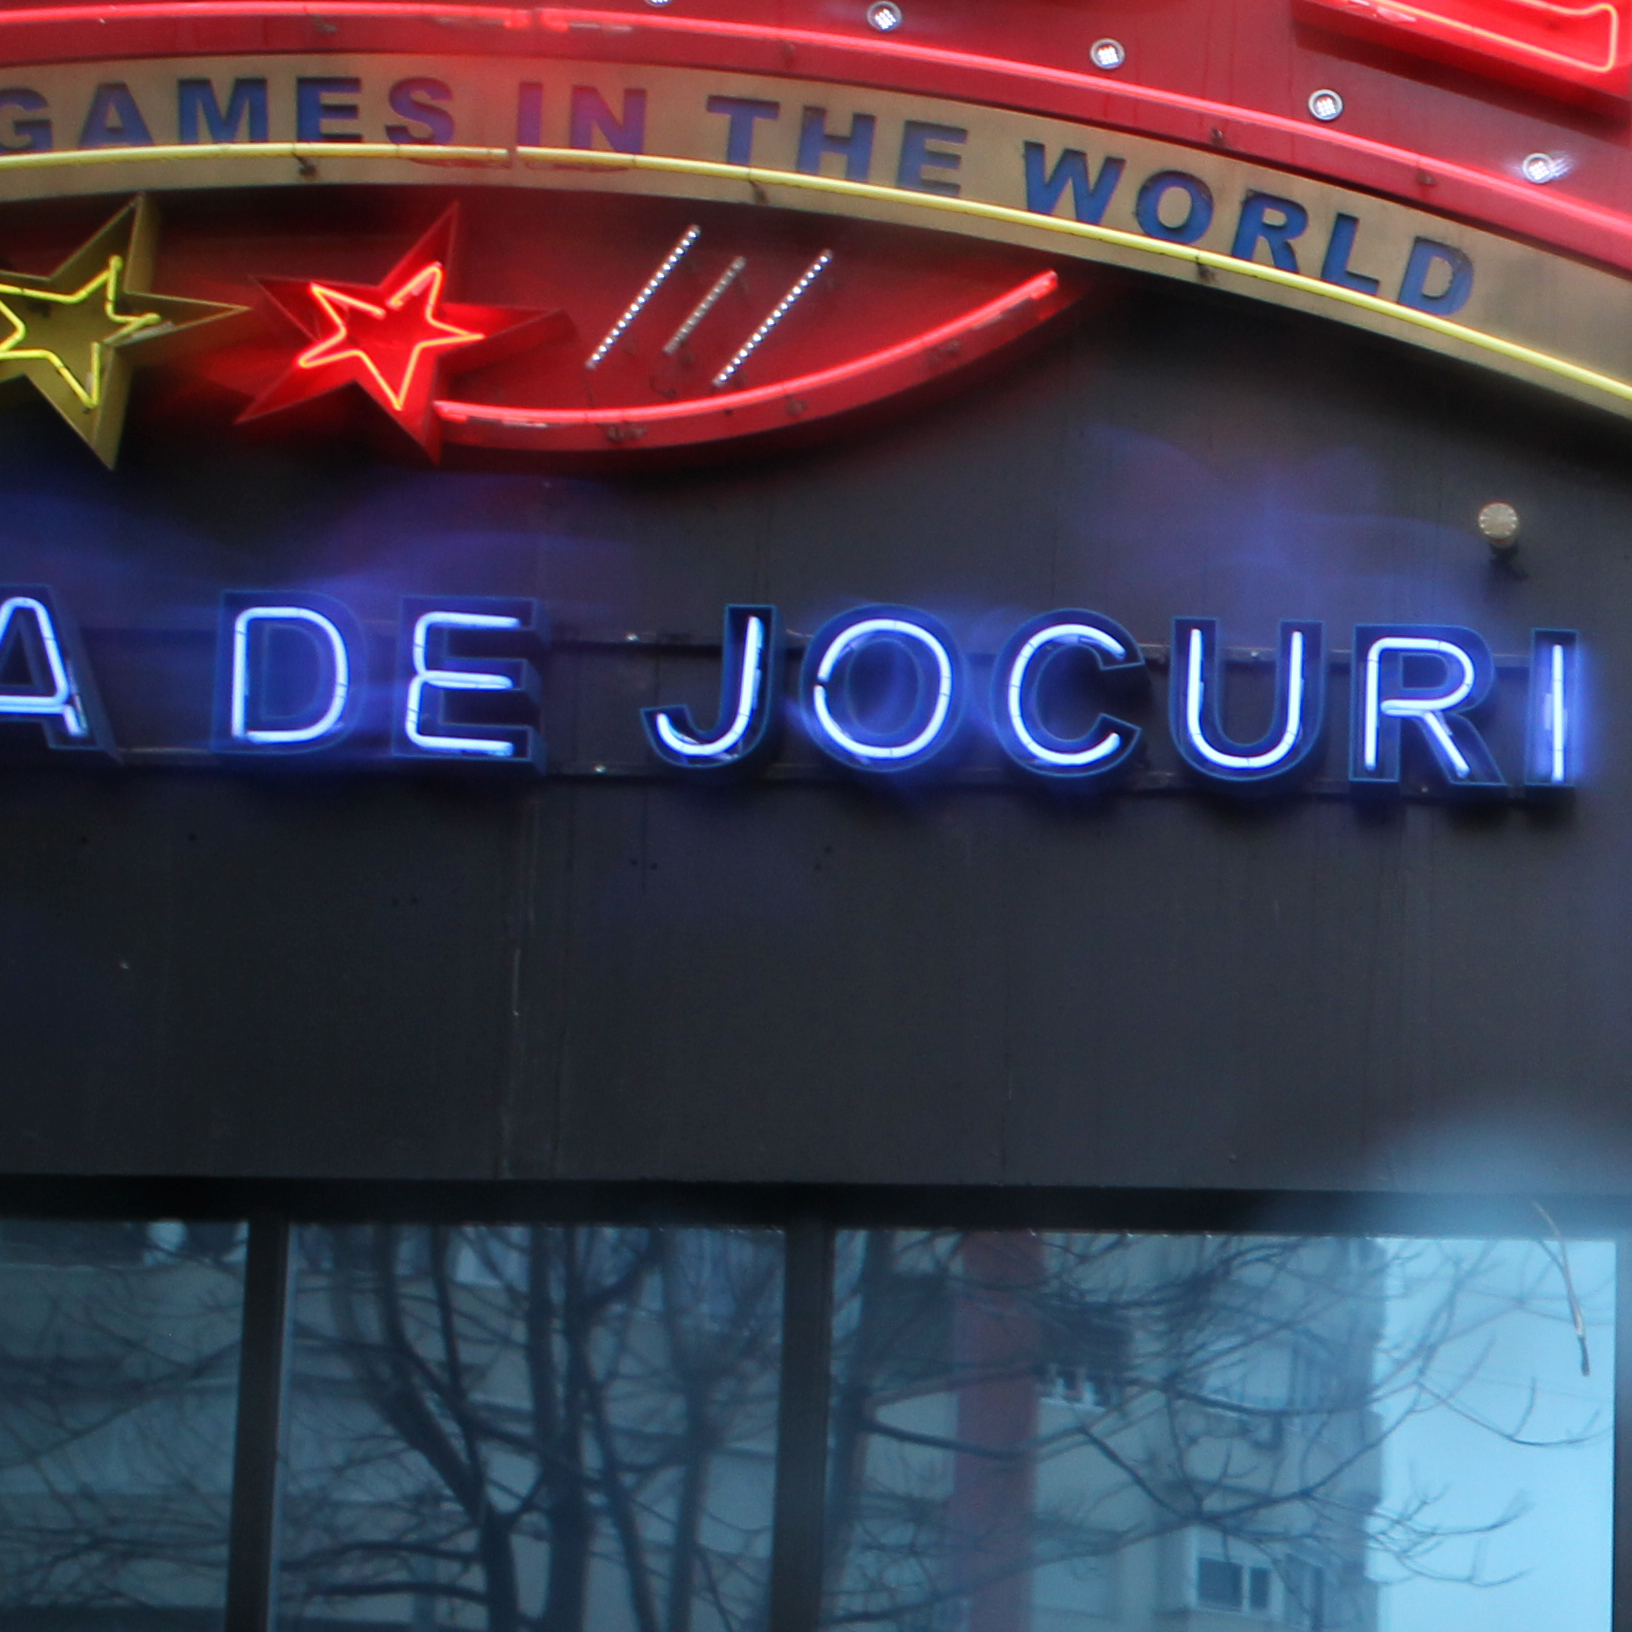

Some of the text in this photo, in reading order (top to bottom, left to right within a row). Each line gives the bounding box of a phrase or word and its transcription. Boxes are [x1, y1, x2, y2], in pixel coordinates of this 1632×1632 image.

[516, 81, 647, 157] IN
[705, 94, 968, 197] THE
[1022, 141, 1477, 317] WORLD
[214, 592, 544, 772] DE
[645, 605, 1583, 788] JOCURI
